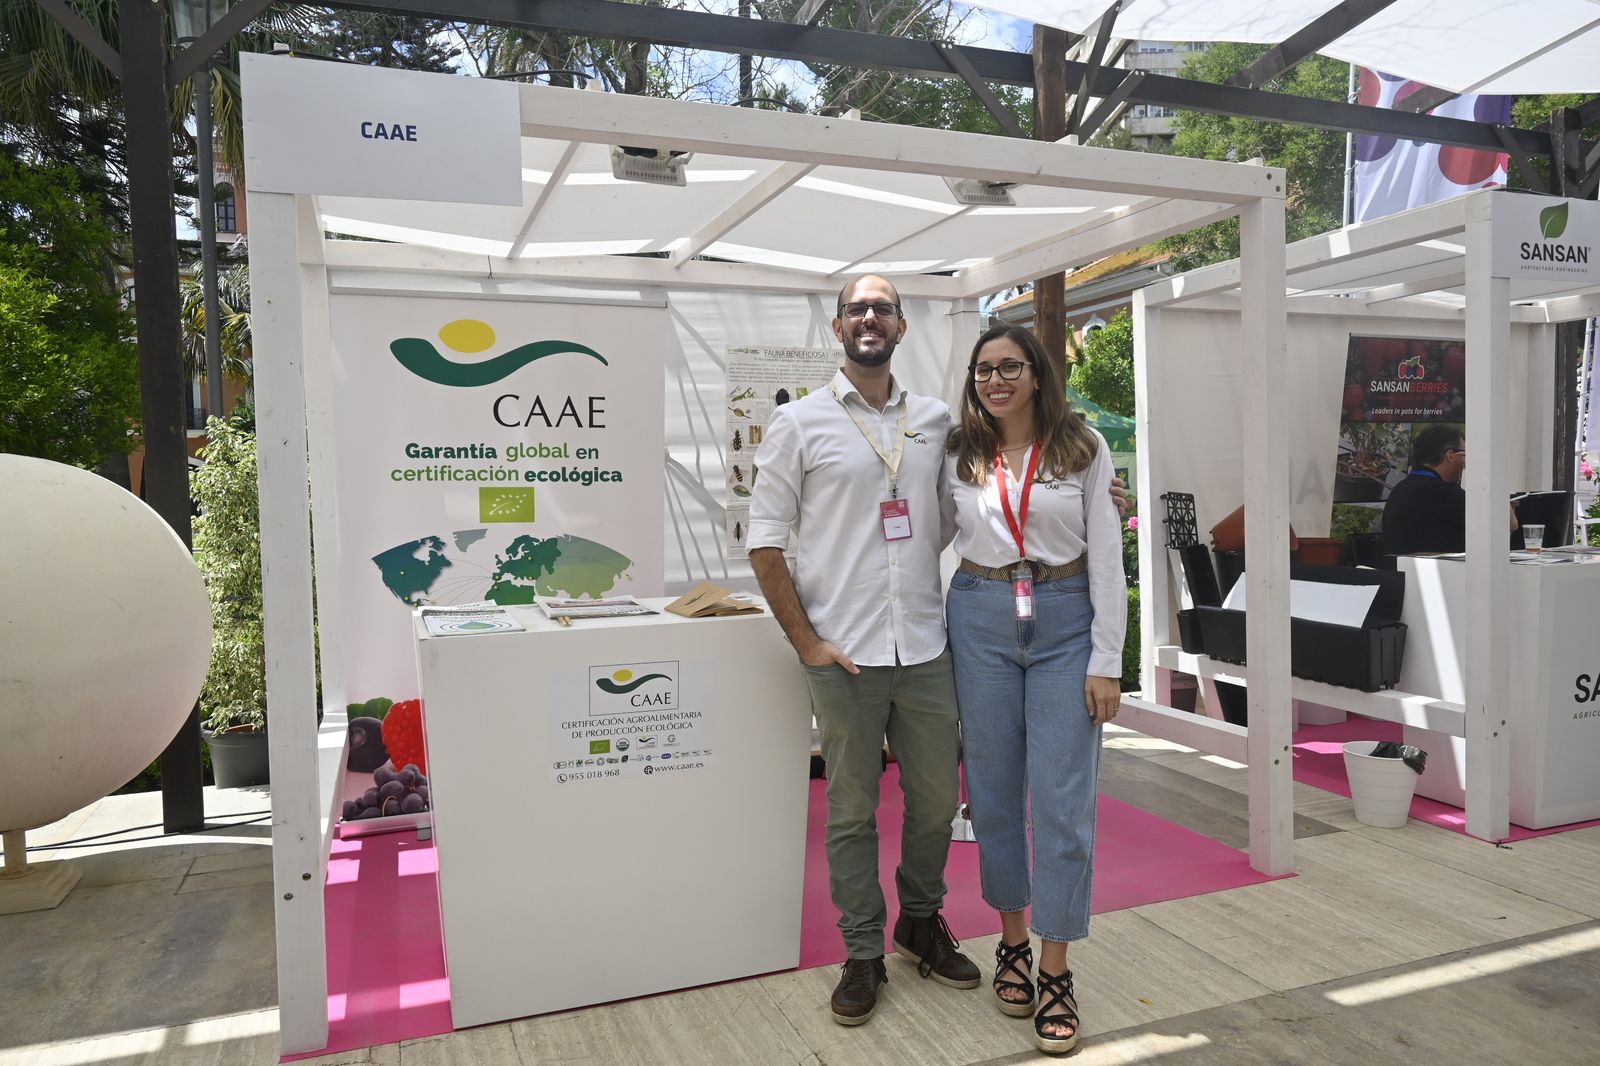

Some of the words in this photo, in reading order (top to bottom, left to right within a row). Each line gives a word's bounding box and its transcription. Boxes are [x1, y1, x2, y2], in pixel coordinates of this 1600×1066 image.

[360, 121, 418, 142] CAAE
[764, 349, 785, 358] FAUNA
[786, 349, 826, 359] BENEFICIOSA
[1370, 380, 1449, 393] SANSANBERRIES
[492, 394, 606, 429] CAAE
[1371, 407, 1393, 415] Leaders
[1401, 408, 1414, 416] pots
[1414, 408, 1423, 416] for
[1423, 407, 1443, 415] berries
[405, 442, 498, 459] Garantía
[505, 442, 570, 462] global
[575, 446, 599, 460] en
[390, 464, 520, 482] certificación
[524, 466, 623, 486] ecológica
[630, 692, 673, 708] CAAE
[561, 716, 625, 730] CERTIFICACIÓN
[626, 711, 703, 725] AGROALIMENTARIA
[571, 730, 584, 739] DE
[585, 725, 644, 738] PRODUCCIÓN
[645, 721, 694, 733] ECOLÓGICA
[568, 772, 584, 781] 955
[586, 770, 603, 779] 018
[604, 769, 620, 778] 968
[654, 762, 705, 772] www.caae.es
